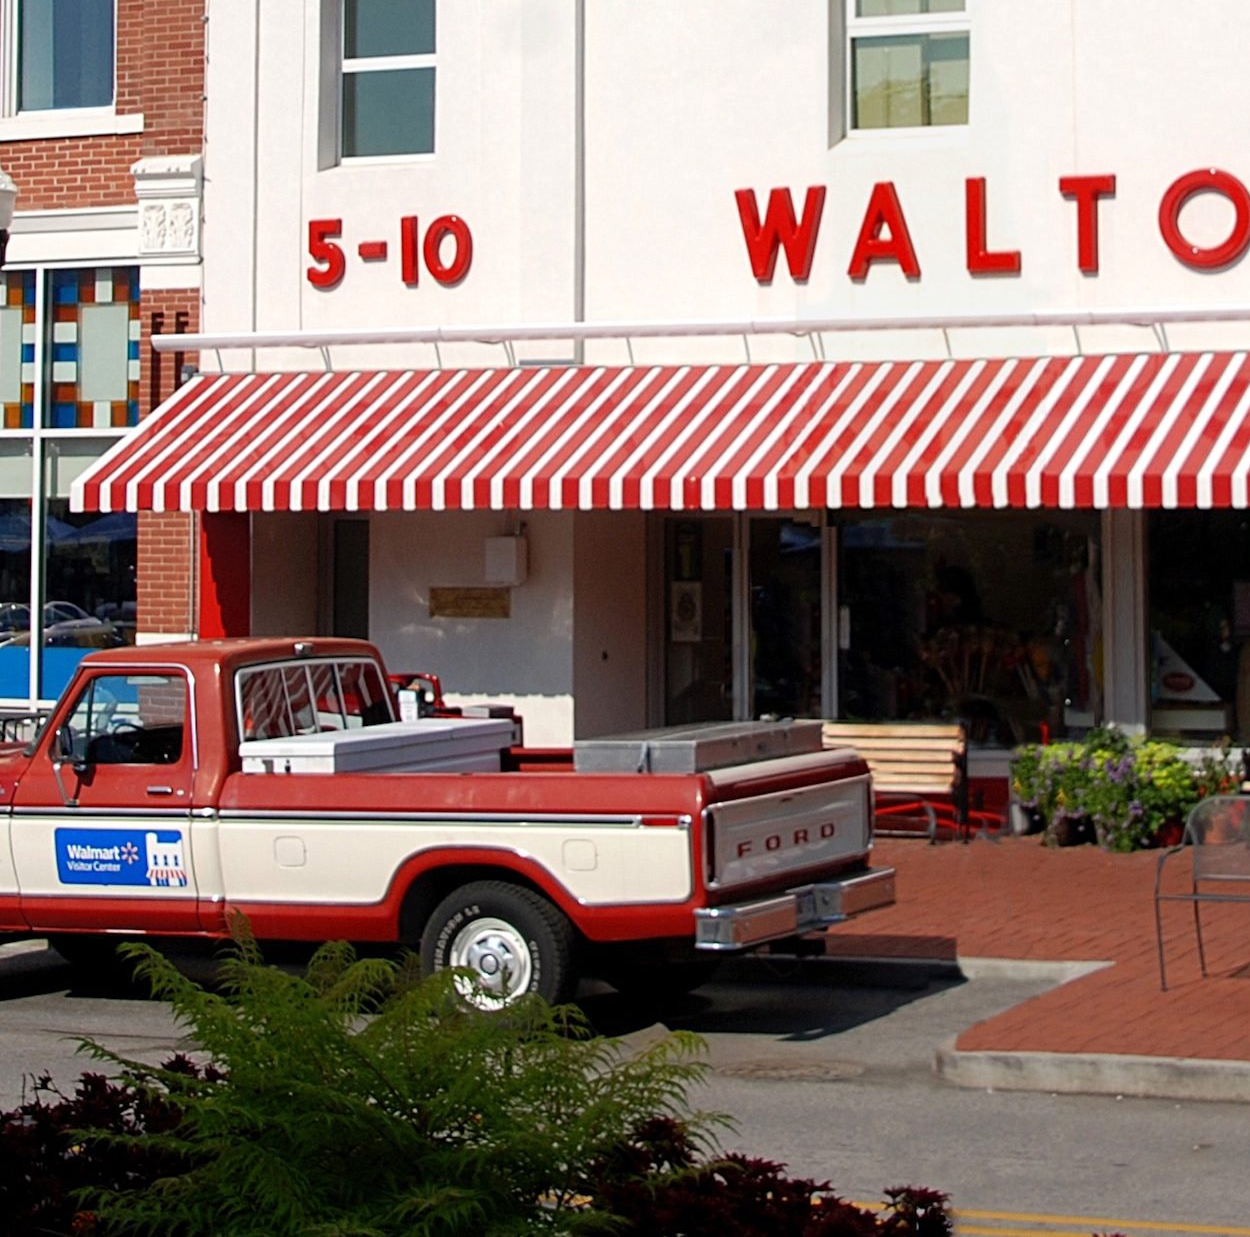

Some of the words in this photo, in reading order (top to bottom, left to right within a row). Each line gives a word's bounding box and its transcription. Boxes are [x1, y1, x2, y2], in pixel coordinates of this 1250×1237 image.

[307, 214, 473, 289] 5-10
[67, 844, 120, 860] Walmart
[737, 823, 835, 858] FORD
[67, 861, 92, 871] Visitor
[93, 861, 121, 872] Center
